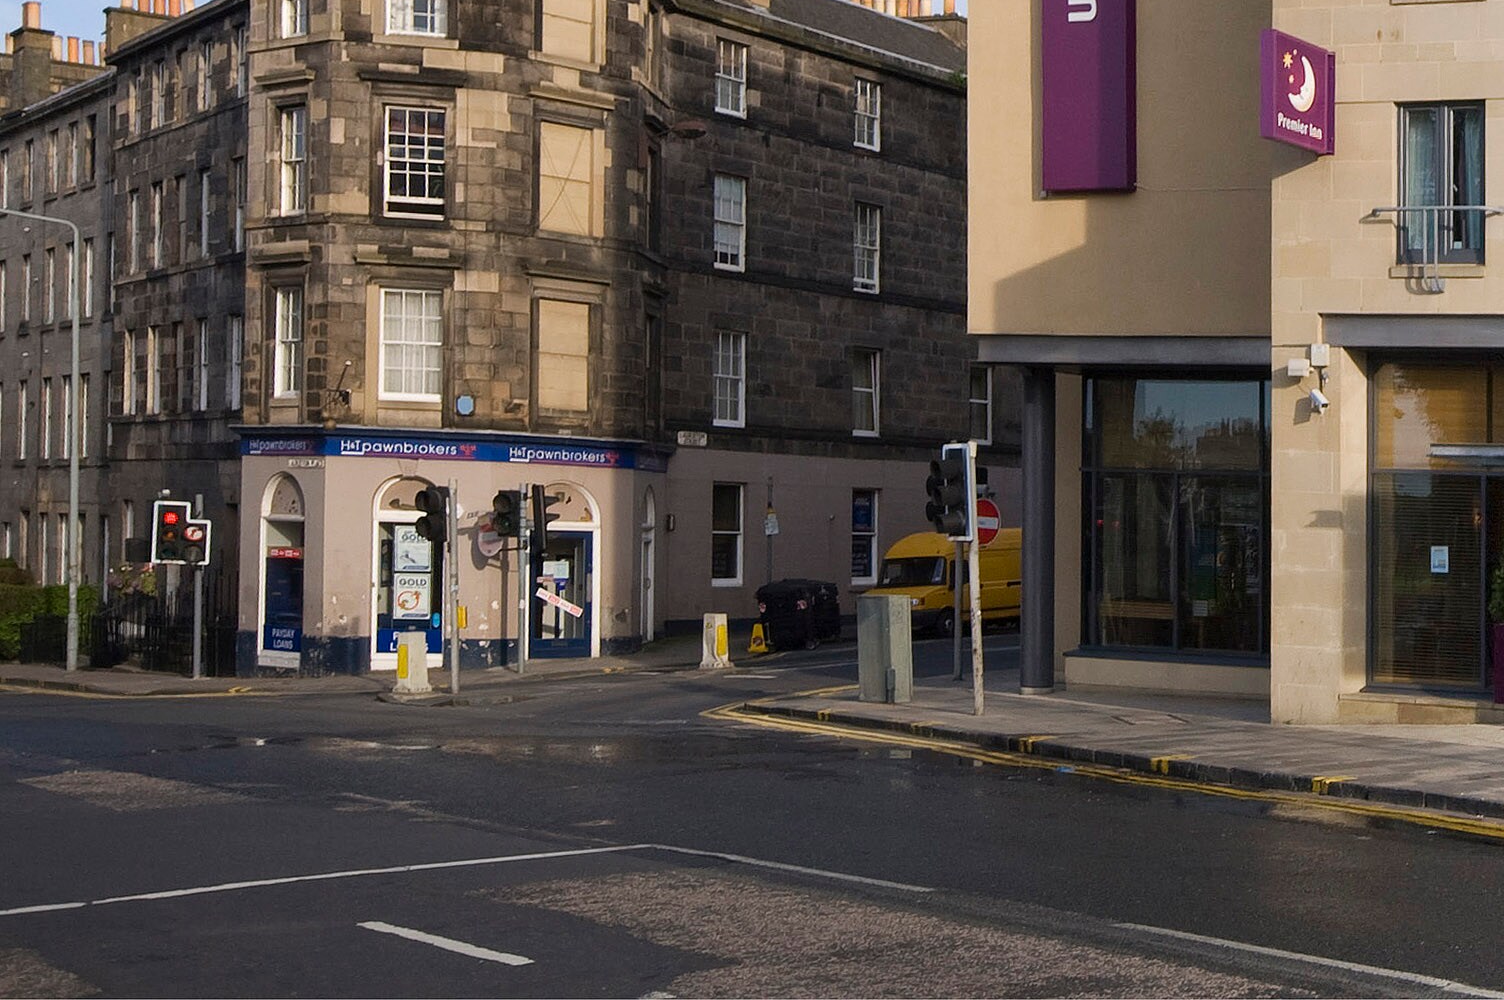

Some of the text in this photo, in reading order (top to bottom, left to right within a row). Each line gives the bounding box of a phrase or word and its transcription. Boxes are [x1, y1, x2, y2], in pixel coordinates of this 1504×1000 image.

[1277, 112, 1323, 140] Premier Inn
[399, 578, 427, 587] GOLD
[271, 628, 296, 639] PAYDAY
[273, 639, 293, 650] LOANS
